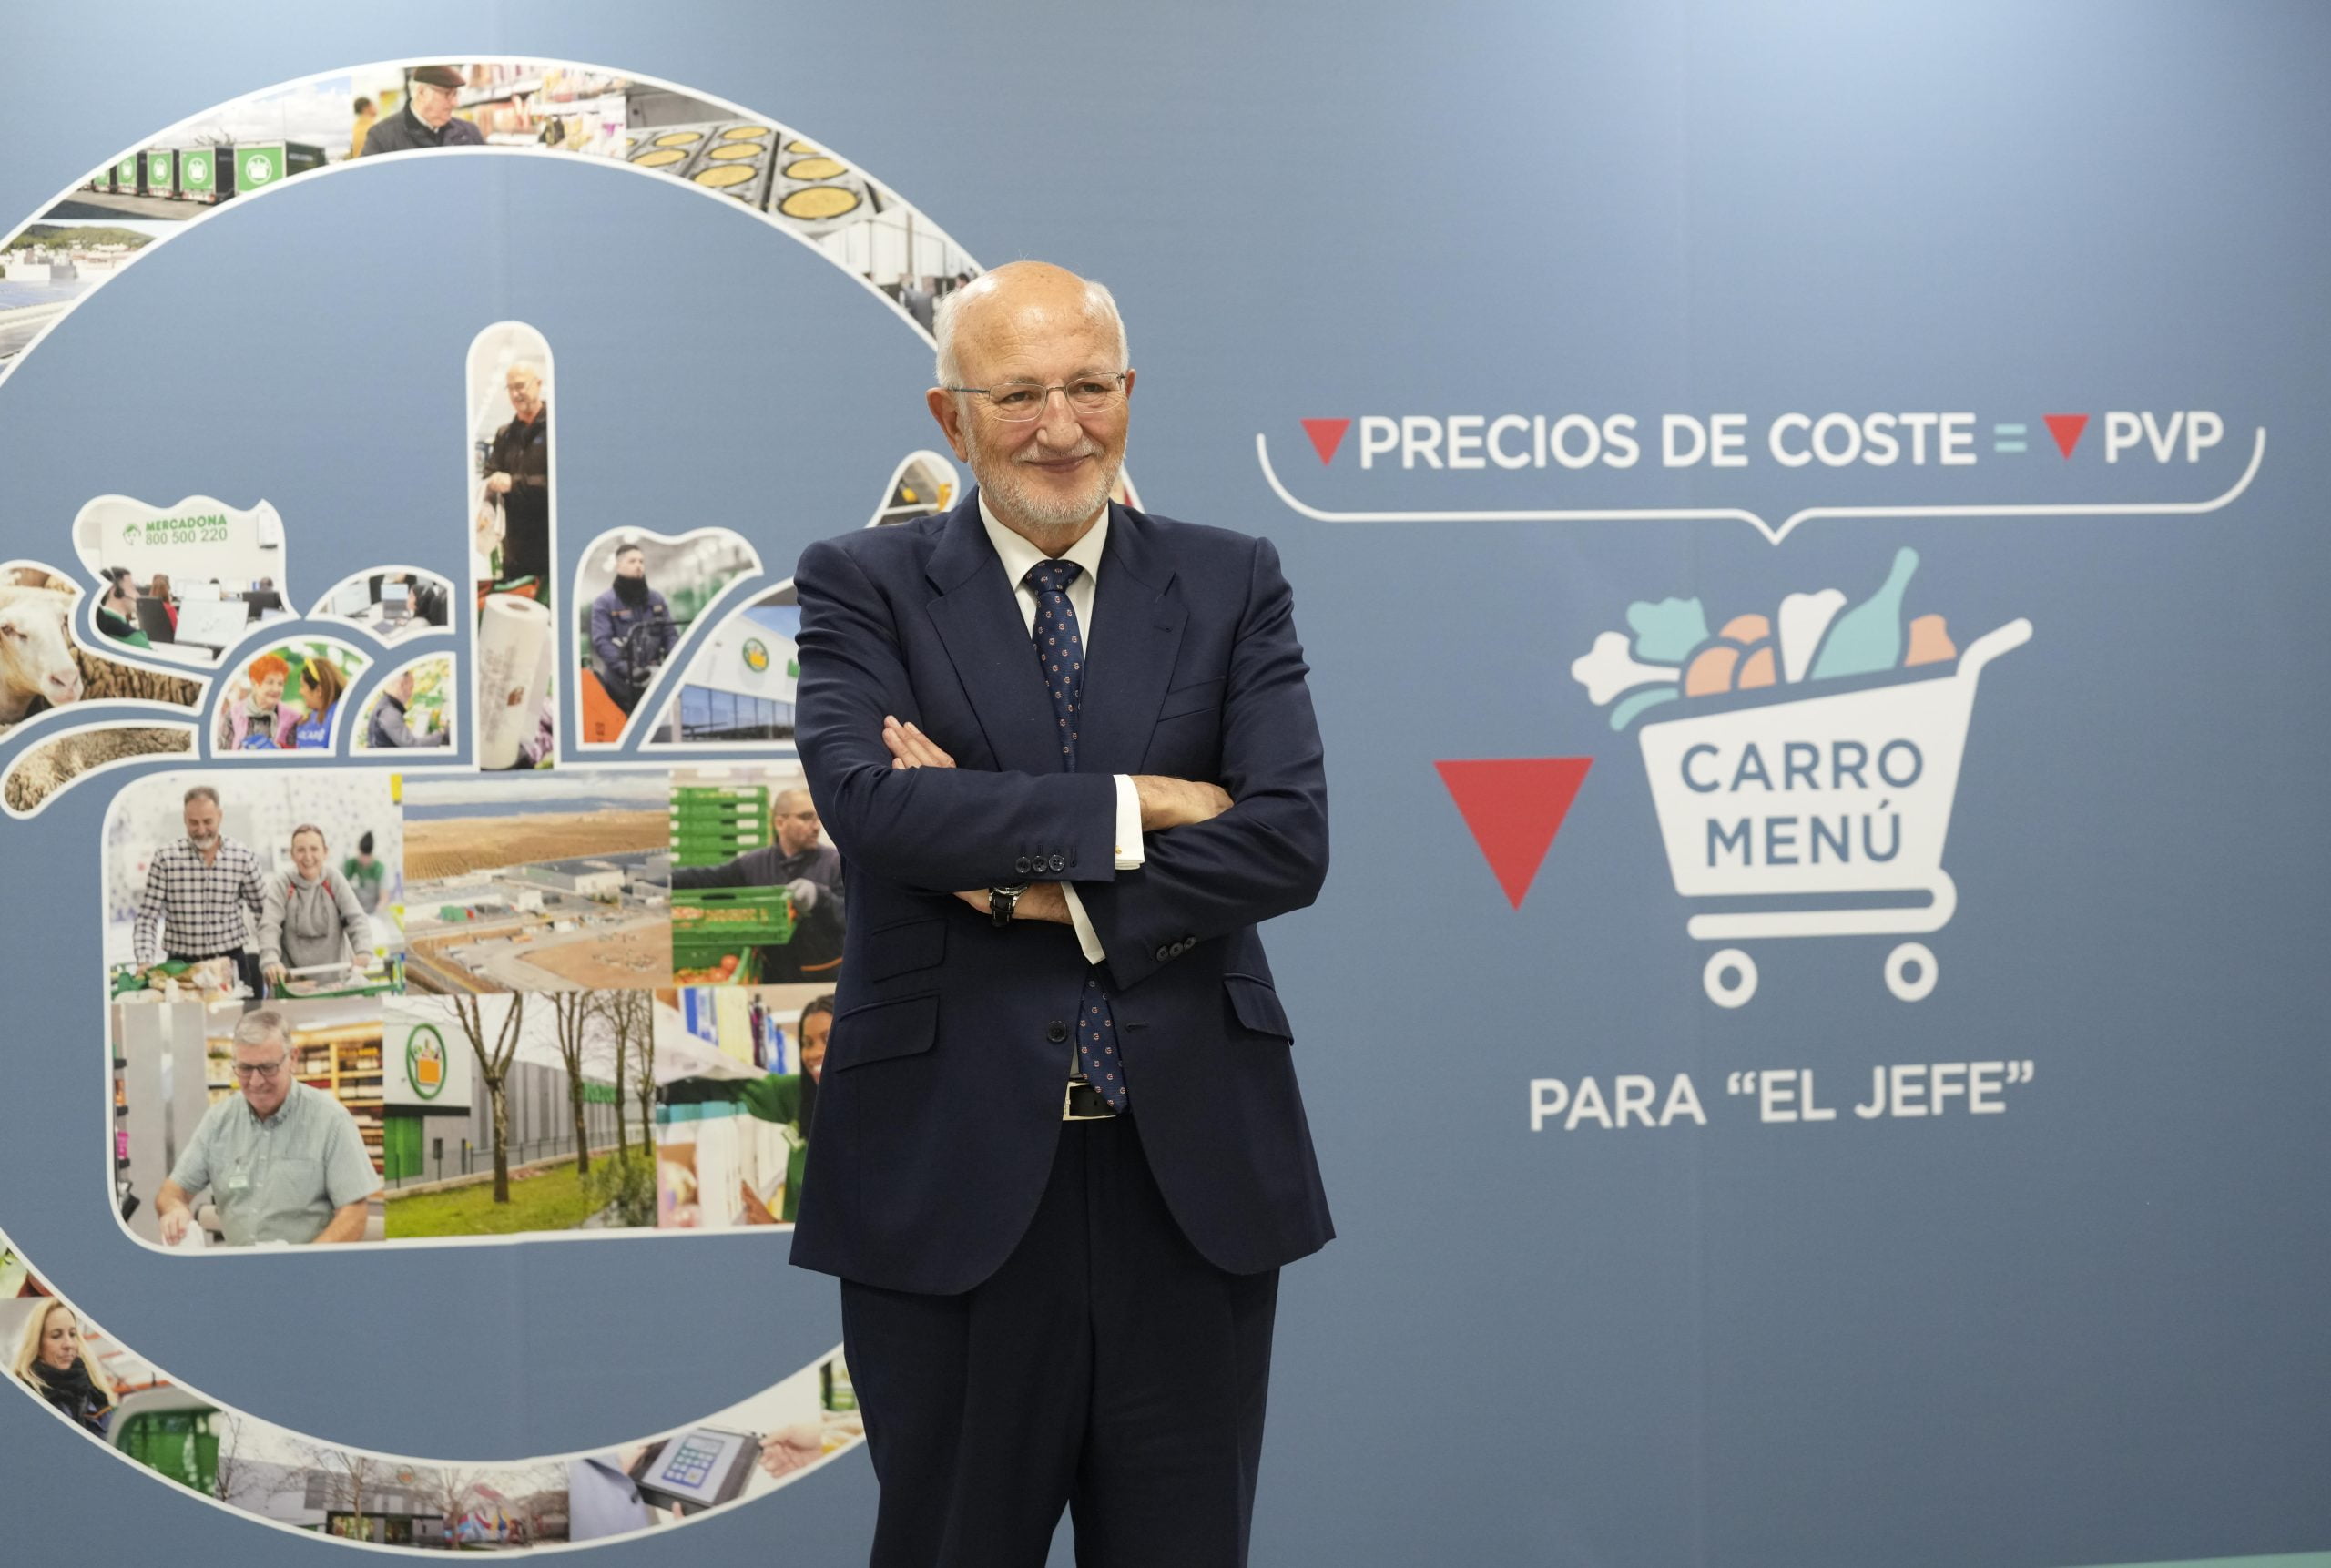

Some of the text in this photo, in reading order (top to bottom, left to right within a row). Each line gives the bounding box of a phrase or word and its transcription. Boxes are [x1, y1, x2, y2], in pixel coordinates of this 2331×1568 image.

[1359, 413, 1641, 470] PRECIOS
[1662, 414, 1749, 468] DE
[1769, 412, 1977, 467] COSTE
[2105, 411, 2224, 463] PVP
[146, 514, 227, 531] MERCADONA
[146, 528, 228, 545] 800 500 220
[1681, 738, 1924, 794] CARRO
[1706, 799, 1901, 868] MENÚ
[1531, 1074, 1706, 1131] PARA
